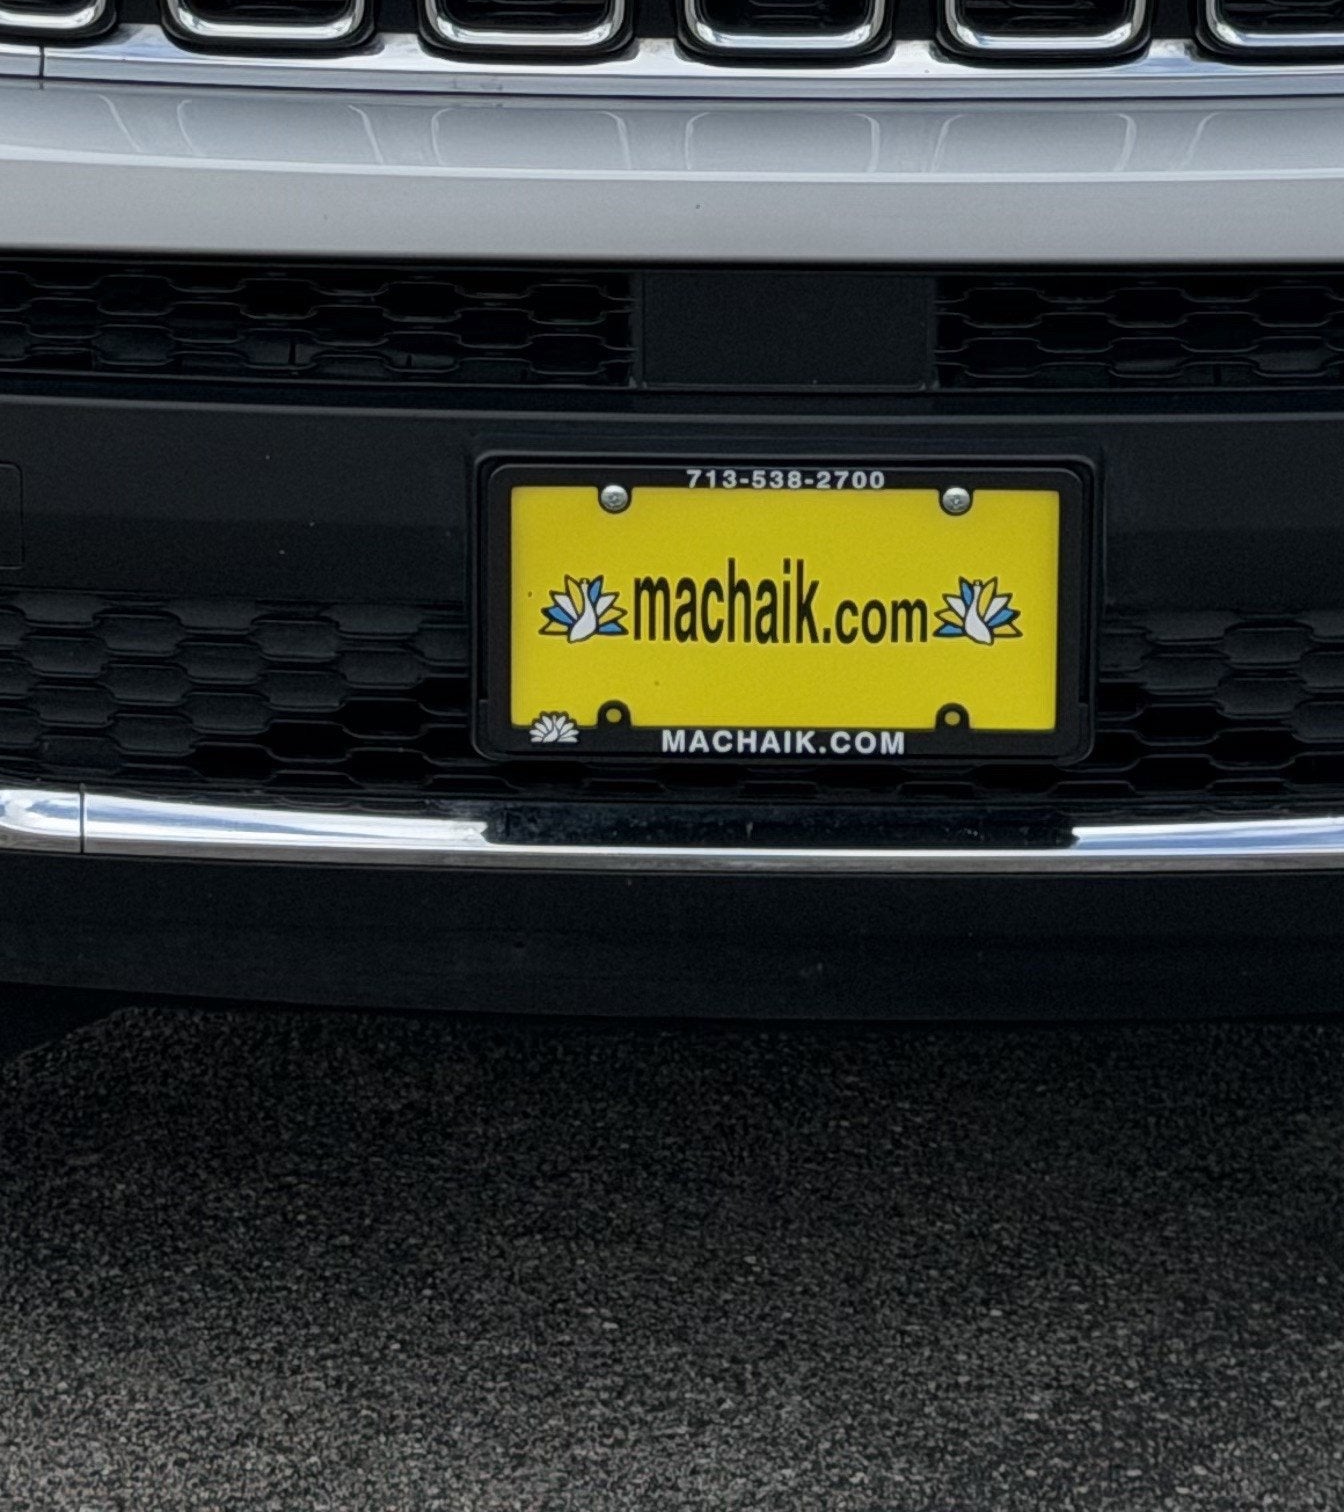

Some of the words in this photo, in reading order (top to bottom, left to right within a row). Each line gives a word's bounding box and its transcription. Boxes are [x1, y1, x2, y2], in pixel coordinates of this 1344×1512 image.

[686, 469, 885, 489] 713-538-2700
[633, 557, 928, 644] machaik.com
[662, 729, 905, 755] MACHAIK.COM
